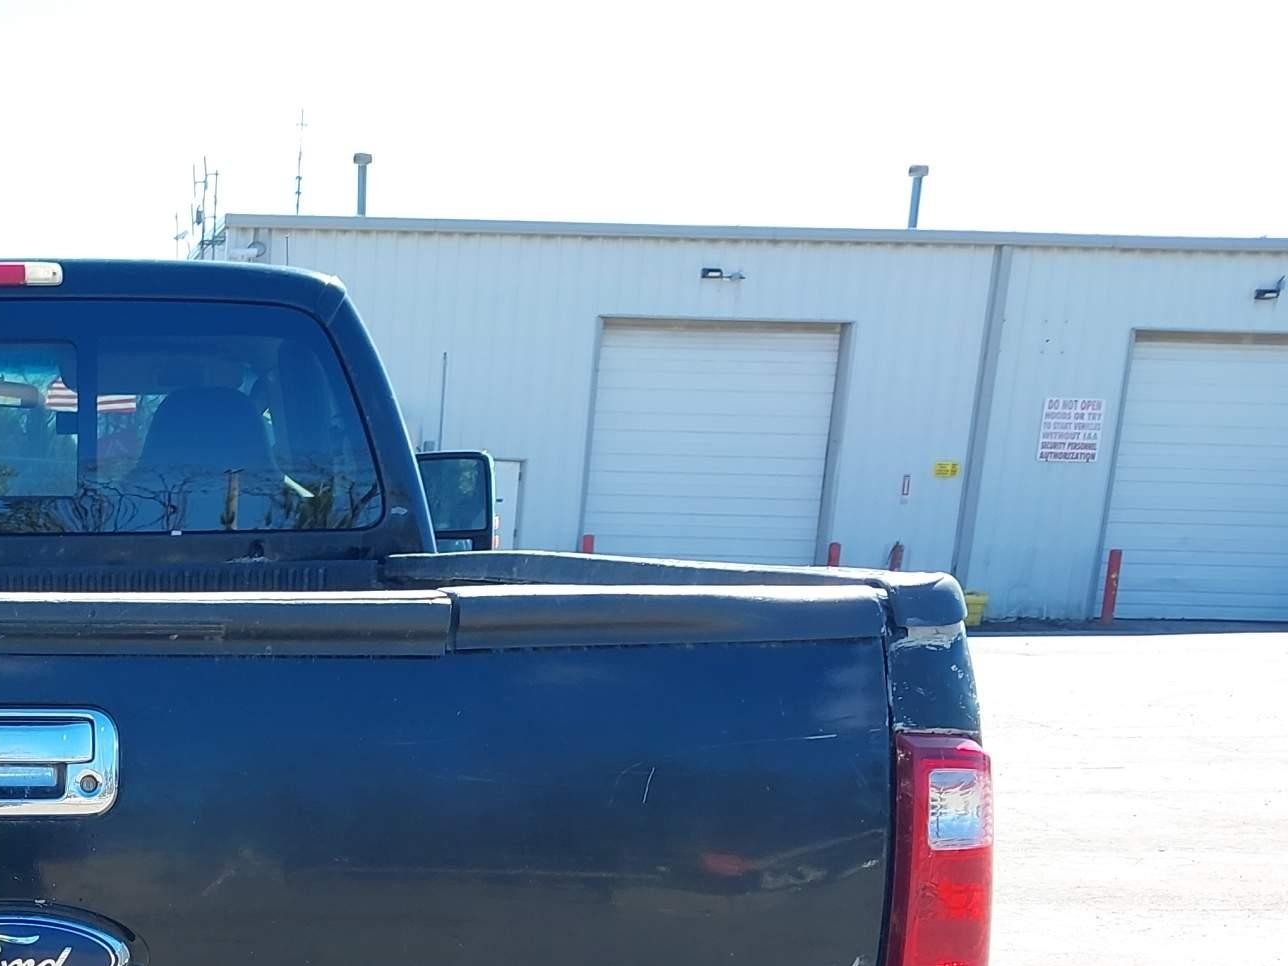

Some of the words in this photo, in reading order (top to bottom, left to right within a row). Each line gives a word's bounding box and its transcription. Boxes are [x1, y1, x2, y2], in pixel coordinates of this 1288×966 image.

[1048, 400, 1060, 410] DO
[1062, 400, 1078, 410] NOT
[1080, 400, 1102, 411] OPEN
[1074, 412, 1086, 420] OR
